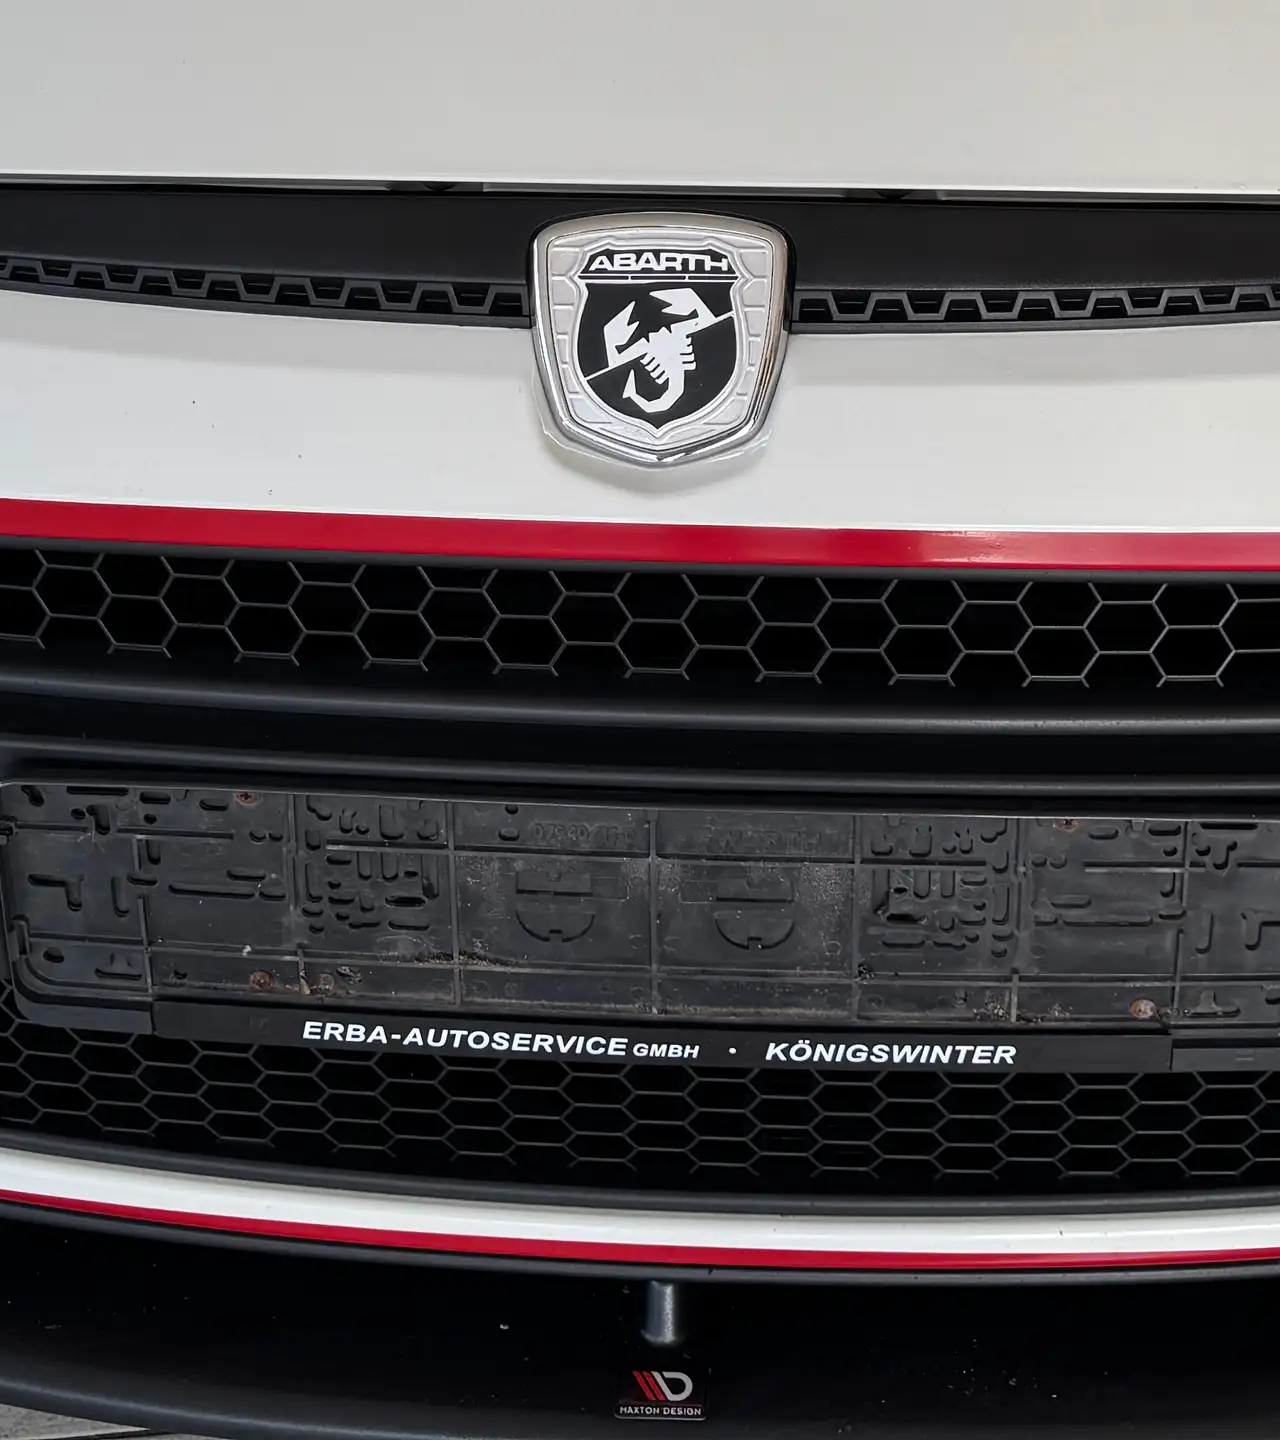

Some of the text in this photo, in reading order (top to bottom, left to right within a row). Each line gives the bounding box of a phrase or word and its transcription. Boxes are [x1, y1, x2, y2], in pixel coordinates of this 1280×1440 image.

[588, 251, 730, 273] ABARTH
[302, 1020, 1018, 1065] ERBA-AUTOSERVICE GMBH KÖNIGSWINTER
[619, 1406, 702, 1416] MAXTON DESIGN
